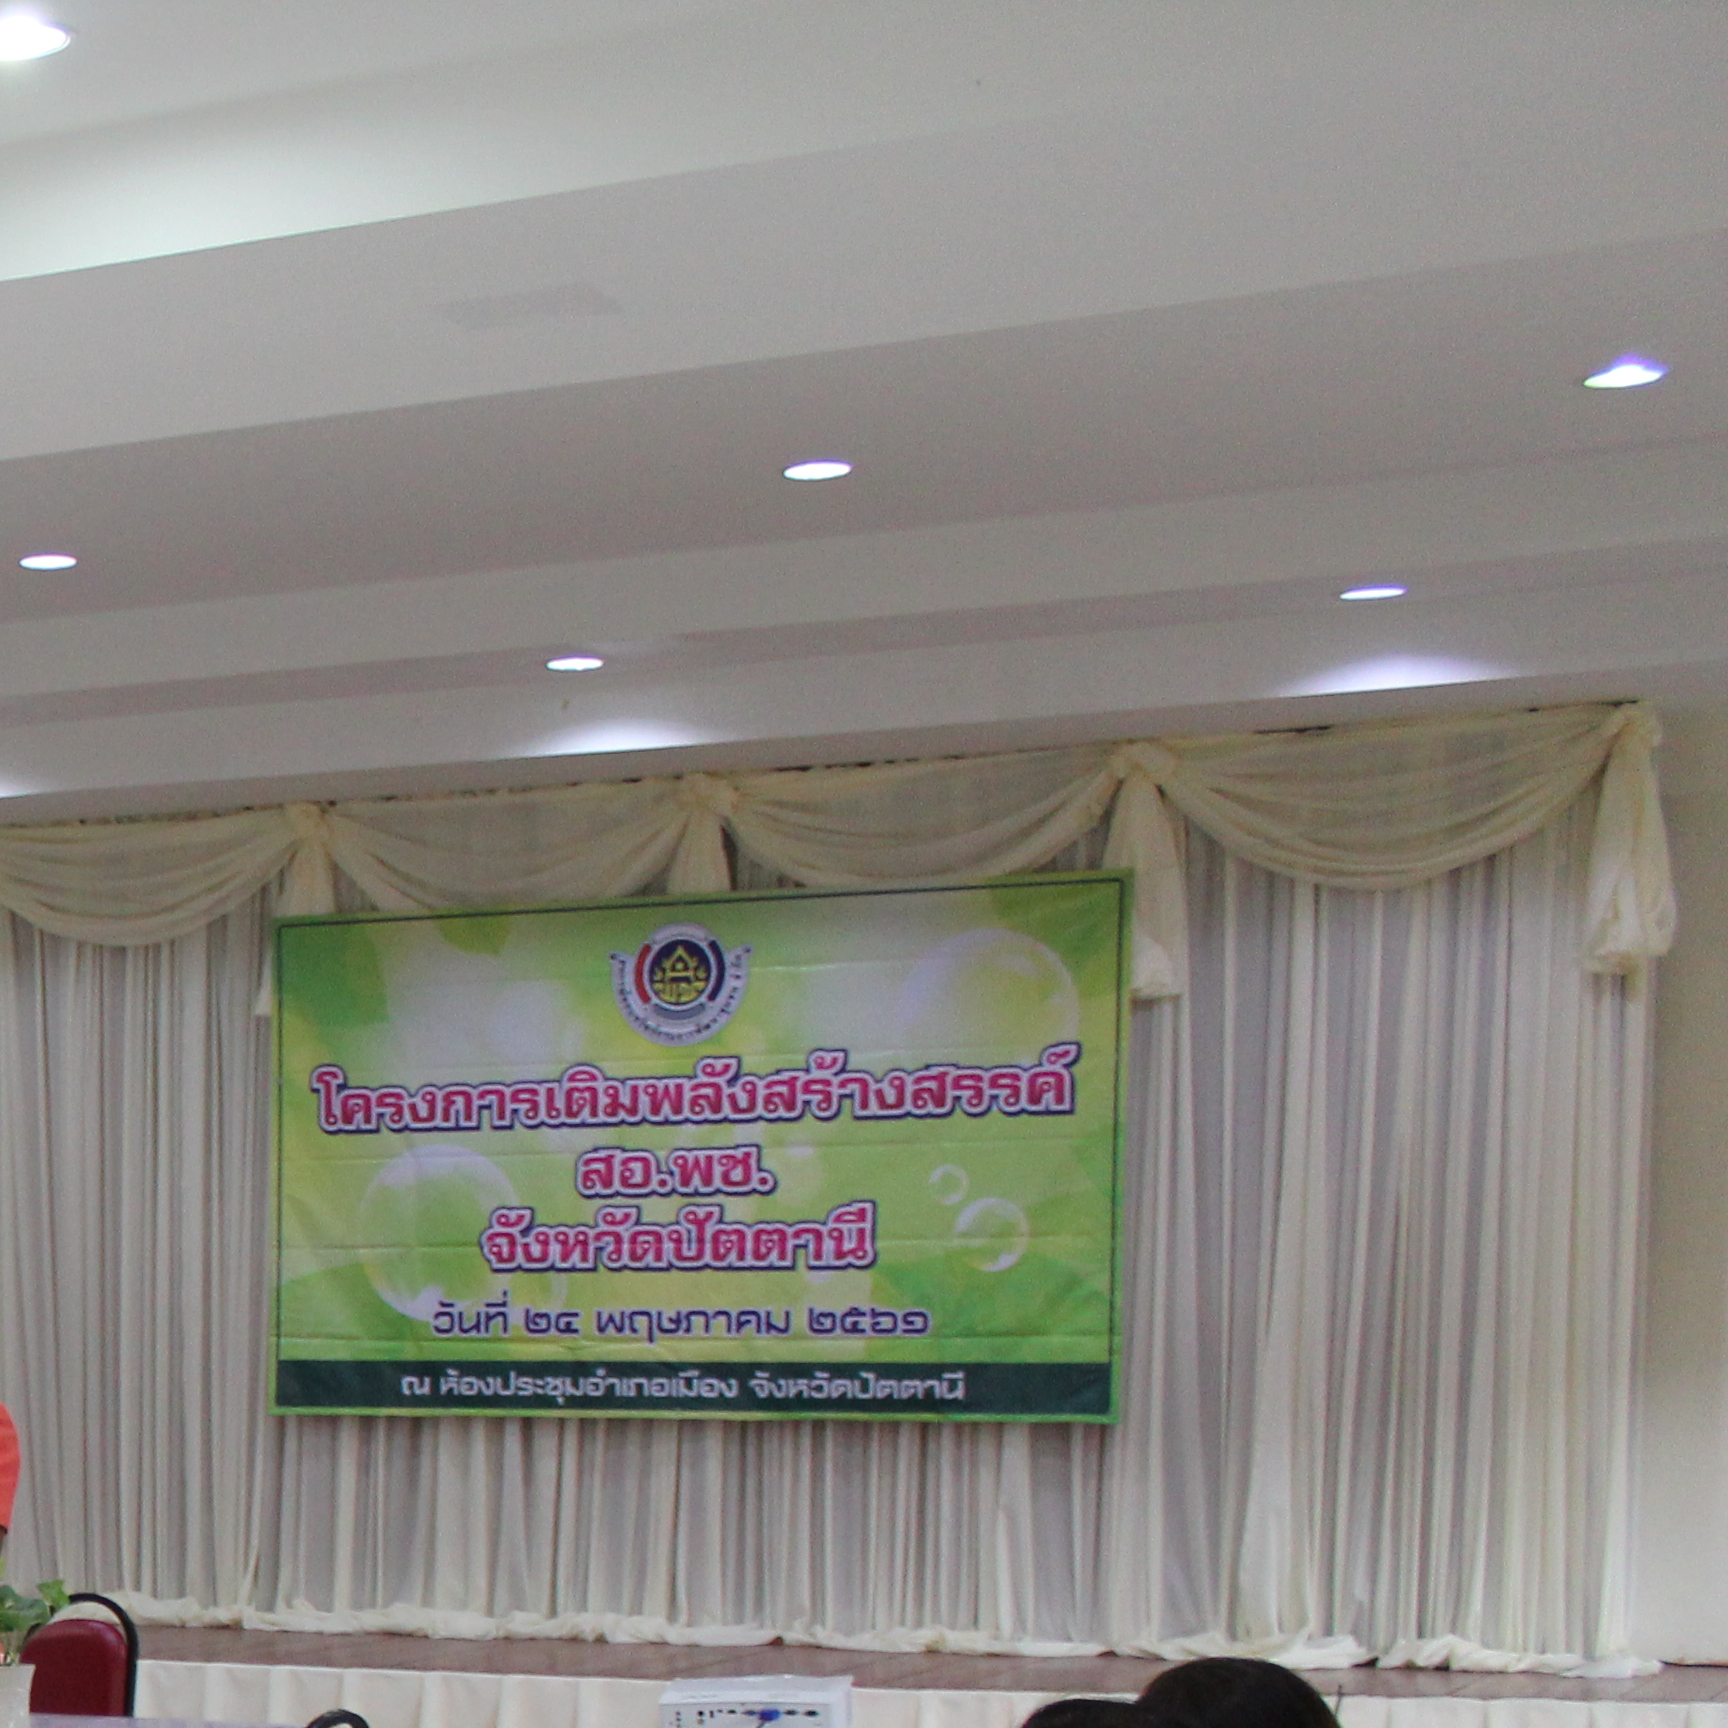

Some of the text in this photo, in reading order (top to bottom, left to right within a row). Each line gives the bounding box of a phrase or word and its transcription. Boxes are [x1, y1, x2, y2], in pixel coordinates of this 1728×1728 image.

[313, 1043, 1080, 1132] โครงการเติมพลังสร้างสรรค์
[578, 1144, 775, 1197] สอ.พช.
[481, 1202, 877, 1273] จังหวัดปัตตานี
[432, 1290, 930, 1343] วันที่ ๒๔ พฤษภาคม ๒๕๖๑
[402, 1369, 966, 1404] ณ ห้องประชุมอำเภอเมือง จังหวัดปัตตานี
